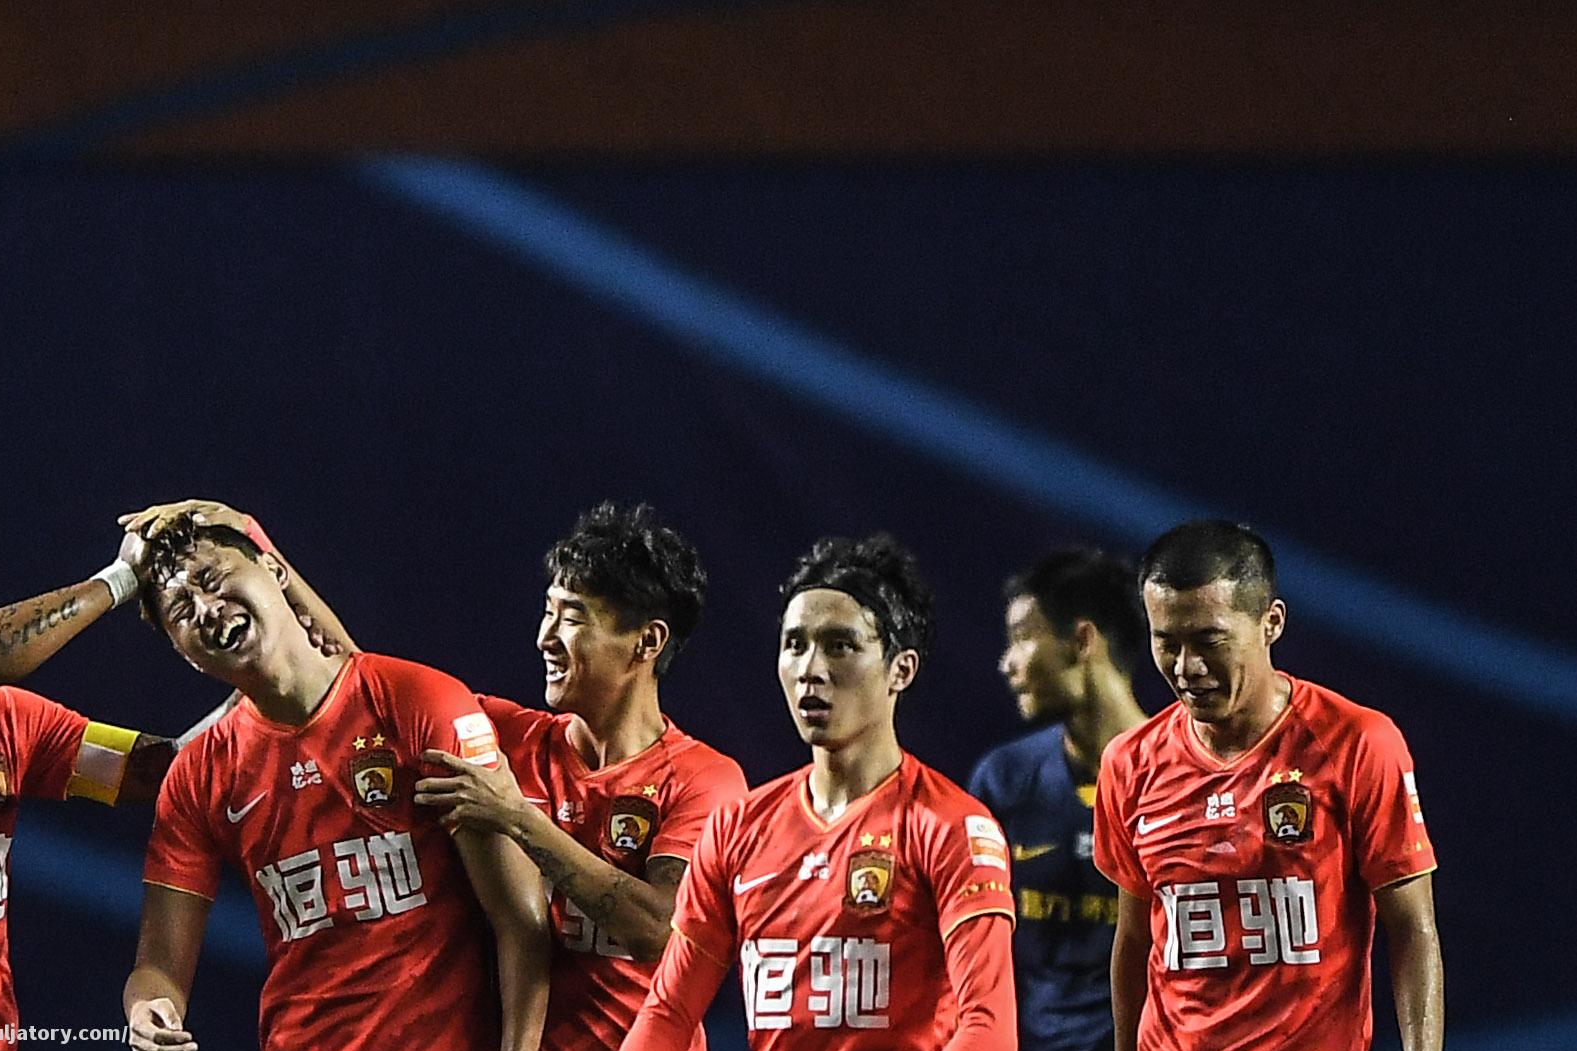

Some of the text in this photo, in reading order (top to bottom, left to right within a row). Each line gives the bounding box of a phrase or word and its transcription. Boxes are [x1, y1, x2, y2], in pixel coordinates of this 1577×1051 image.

[256, 831, 427, 943] 恒驰
[1154, 876, 1320, 971] 恒驰
[740, 936, 890, 1031] 恒驰
